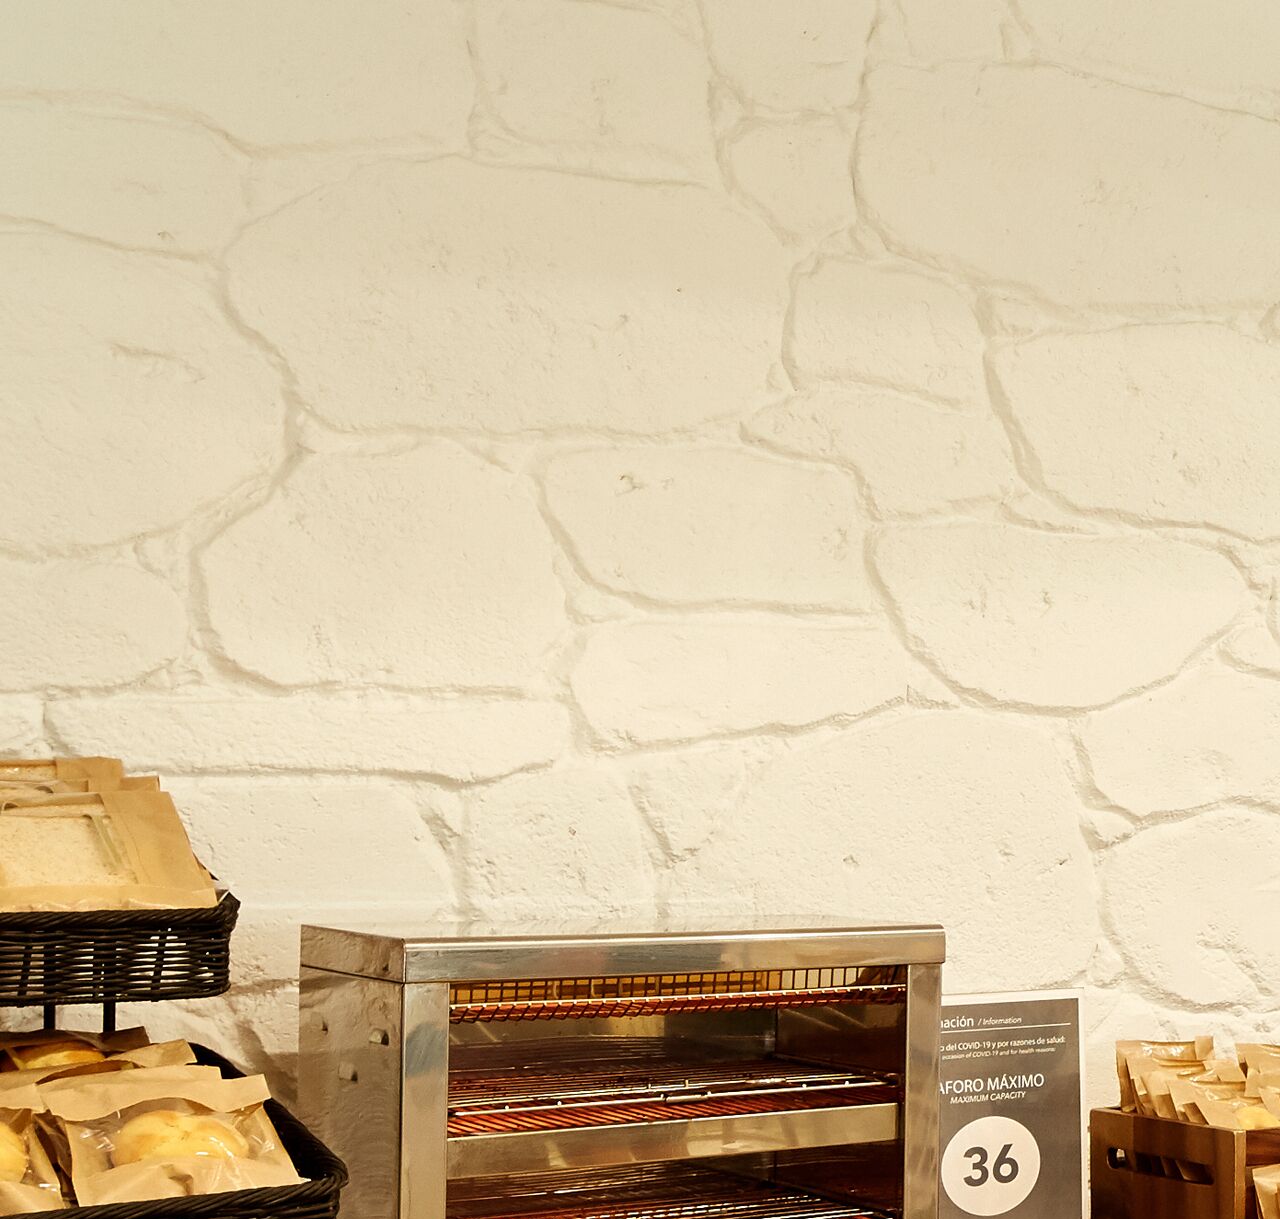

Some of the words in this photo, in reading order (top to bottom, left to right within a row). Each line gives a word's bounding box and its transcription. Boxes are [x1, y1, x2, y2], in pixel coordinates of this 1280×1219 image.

[940, 1016, 974, 1028] ación
[983, 1016, 1022, 1025] Information
[946, 1042, 957, 1051] del
[958, 1040, 991, 1050] COVID-19
[991, 1041, 996, 1049] y
[997, 1040, 1009, 1049] por
[1010, 1038, 1036, 1047] razones
[1037, 1037, 1045, 1045] de
[972, 1050, 999, 1059] COVID-19
[939, 1078, 984, 1095] AFORO
[987, 1073, 1045, 1091] MÁXIMO
[950, 1093, 989, 1104] MAXIMUM
[989, 1091, 1027, 1101] CAPACITY
[963, 1143, 1020, 1187] 36
